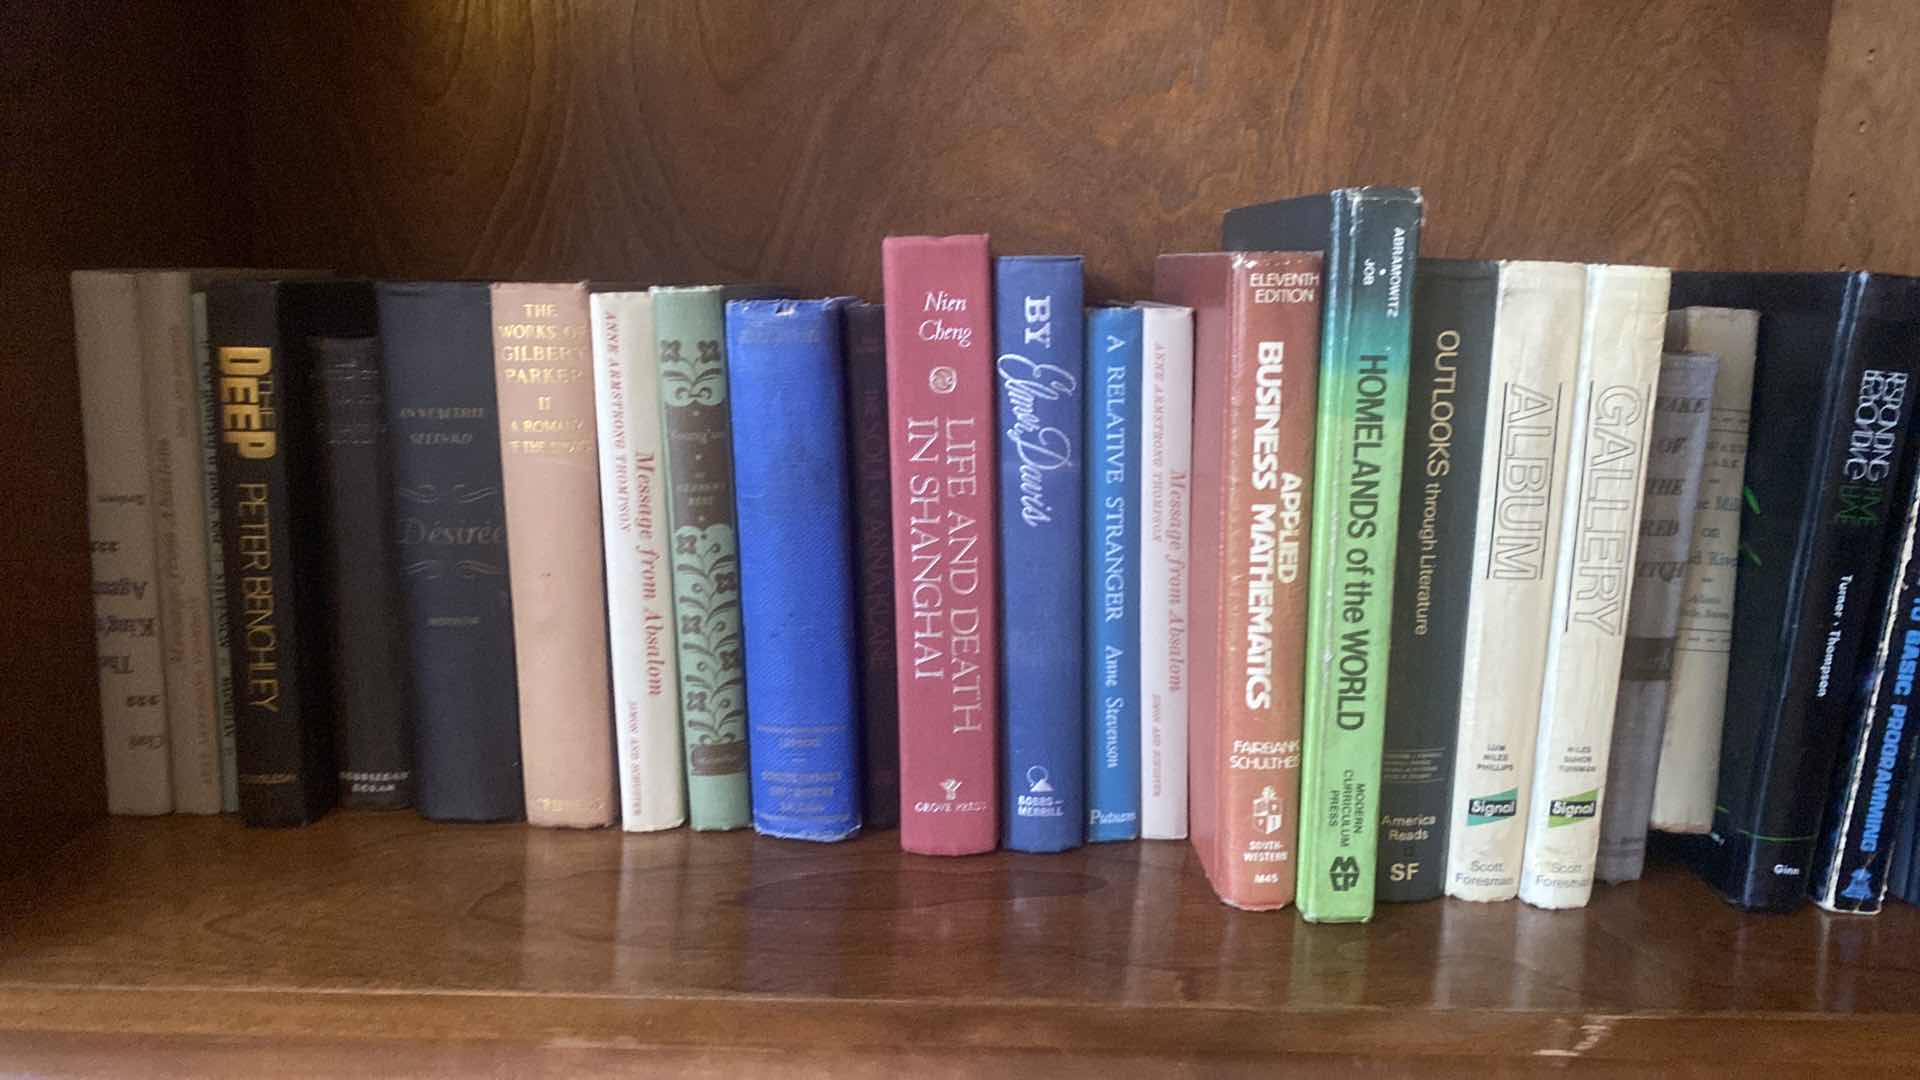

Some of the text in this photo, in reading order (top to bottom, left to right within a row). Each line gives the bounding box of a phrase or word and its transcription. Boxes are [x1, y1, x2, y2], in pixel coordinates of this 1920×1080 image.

[924, 291, 967, 313] Nien
[1250, 272, 1320, 288] ELEVENTH
[1255, 288, 1315, 303] EDITION
[1363, 258, 1376, 287] JOB
[1386, 227, 1407, 318] ABRAMOWITZ
[499, 324, 556, 340] WORKS
[522, 304, 558, 318] THE
[604, 311, 620, 354] ANNE
[918, 320, 972, 348] Cheng
[1024, 296, 1051, 348] BY
[218, 346, 276, 459] DEEP
[504, 368, 584, 384] PARKER
[608, 357, 626, 455] ARMSTRONG
[1414, 329, 1461, 636] OUTLOOKS through Literature
[1493, 383, 1555, 580] ALBUM
[1573, 384, 1643, 636] GALLERY
[907, 416, 944, 680] IN SHANGHAI
[1104, 335, 1126, 768] A RELATIVE STRANGER Anne Stevenson
[1246, 341, 1285, 711] BUSINESS MATHEMATICS
[1277, 472, 1302, 584] APPLIED
[1336, 355, 1388, 731] HOMELANDS of the WORLD
[239, 483, 279, 713] PETER BENCHLEY
[635, 451, 666, 697] Message from Absalom
[946, 417, 983, 734] LIFE AND DEATH
[1166, 470, 1187, 692] Message from Absalom
[1816, 574, 1854, 699] Turner Thompson
[1895, 629, 1920, 697] BASIC
[1328, 790, 1340, 827] PRESS
[1340, 769, 1355, 848] CURRICULUM
[1471, 801, 1515, 816] Signal
[1551, 801, 1595, 817] Signal
[1860, 704, 1908, 852] PROGRAMMING
[1381, 815, 1437, 827] America
[1388, 829, 1430, 841] Reads
[1243, 851, 1288, 863] WESTERN
[1389, 862, 1421, 881] SF
[1773, 864, 1801, 875] Ginn
